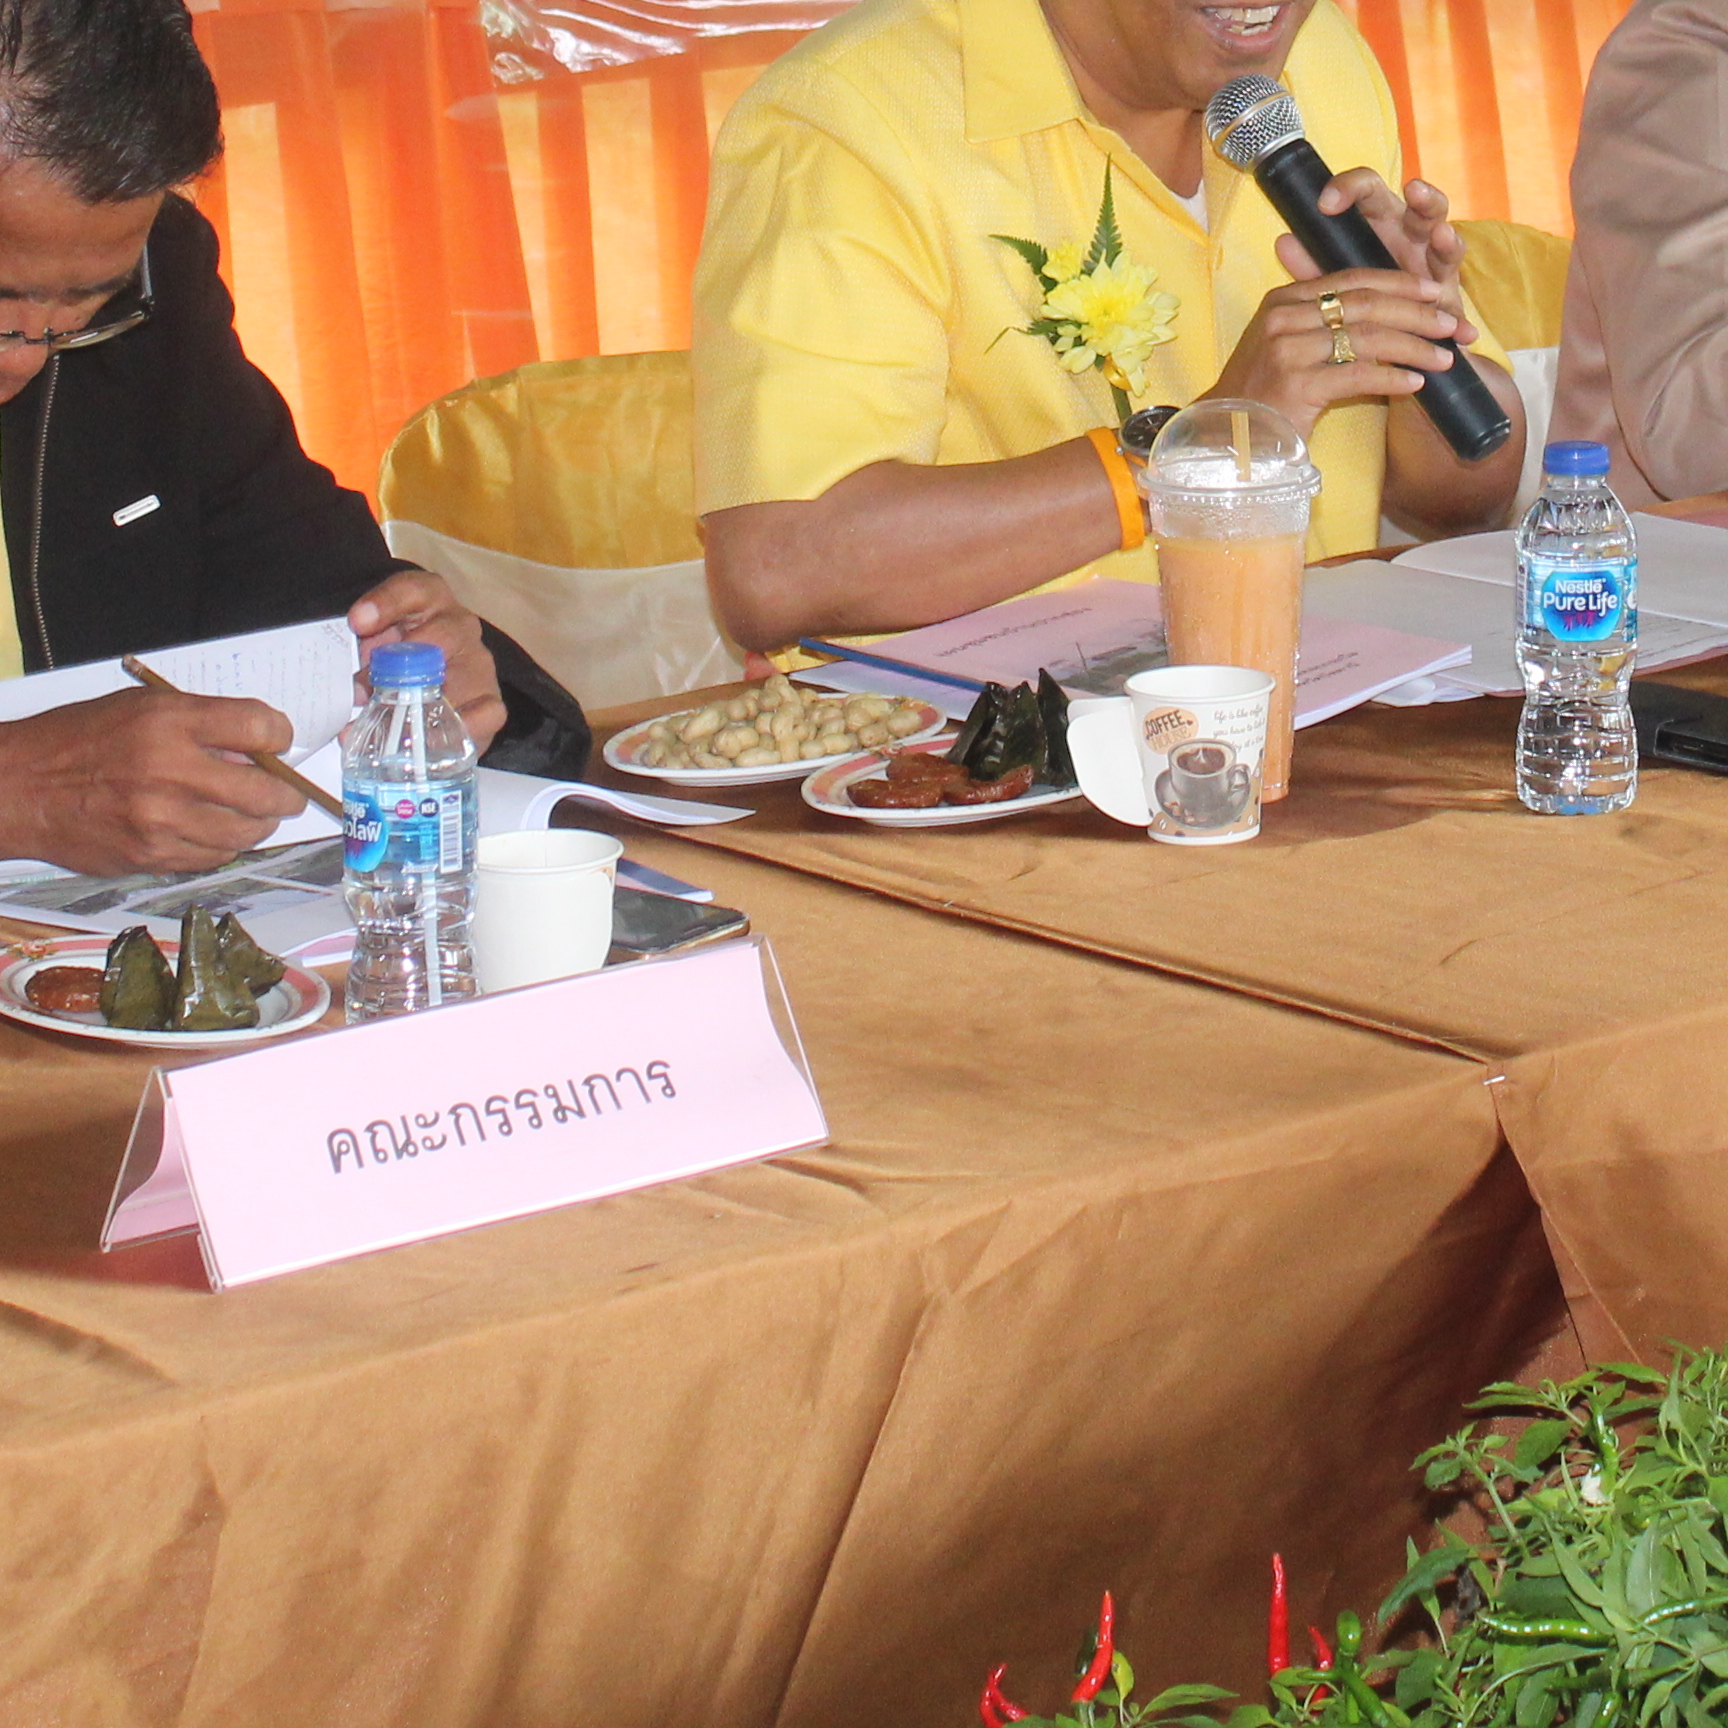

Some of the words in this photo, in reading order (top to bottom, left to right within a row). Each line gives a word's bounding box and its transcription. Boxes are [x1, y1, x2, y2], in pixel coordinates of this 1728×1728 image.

[1542, 590, 1588, 612] Pure
[1588, 590, 1618, 619] Life
[1145, 709, 1186, 738] COFFEE
[325, 1057, 679, 1174] คณะกรรมการ
